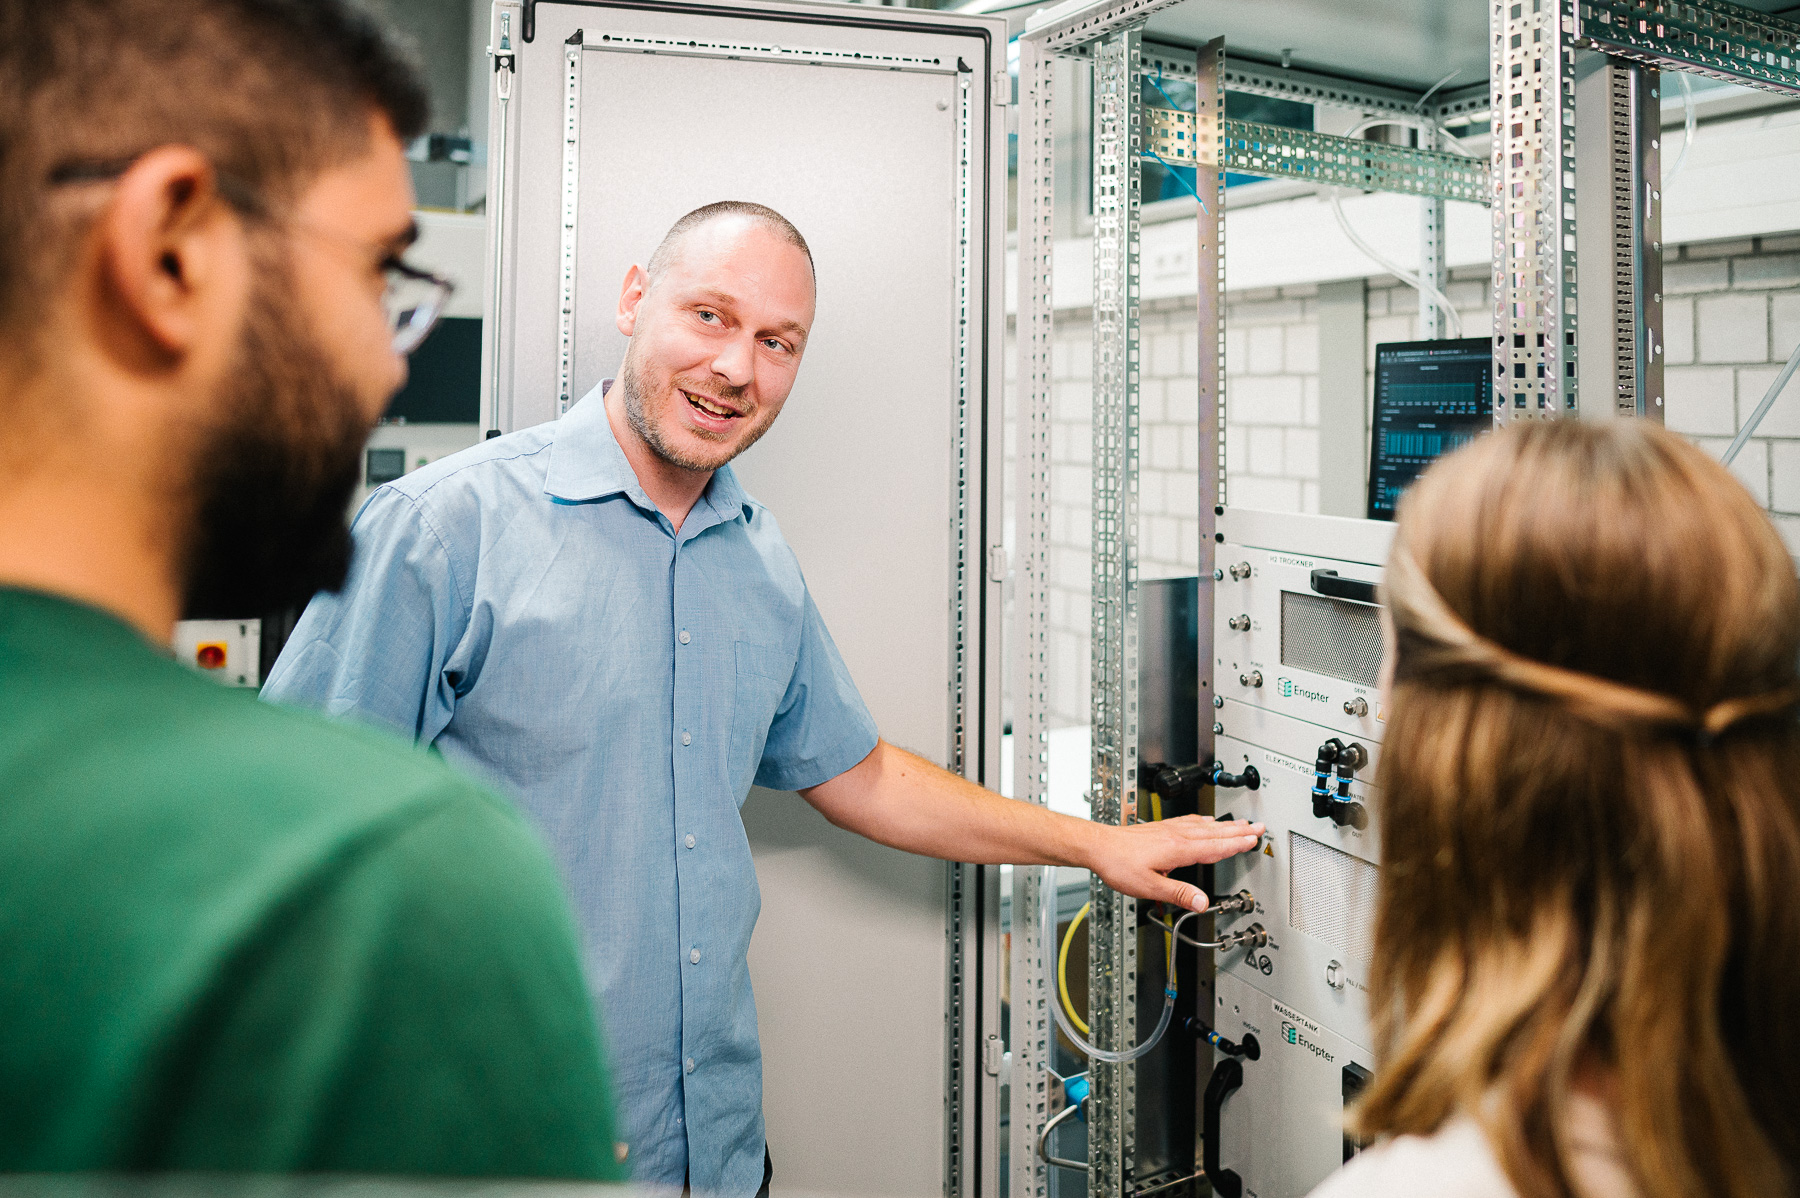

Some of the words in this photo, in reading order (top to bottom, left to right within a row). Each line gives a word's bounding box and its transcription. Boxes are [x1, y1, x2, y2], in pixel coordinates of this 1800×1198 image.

[1279, 557, 1314, 568] TROCKNER
[1294, 685, 1329, 703] Enapter
[1265, 754, 1316, 776] ELEKTROLYSEU
[1274, 1003, 1319, 1034] WASSERTANK
[1298, 1034, 1335, 1063] Enapter
